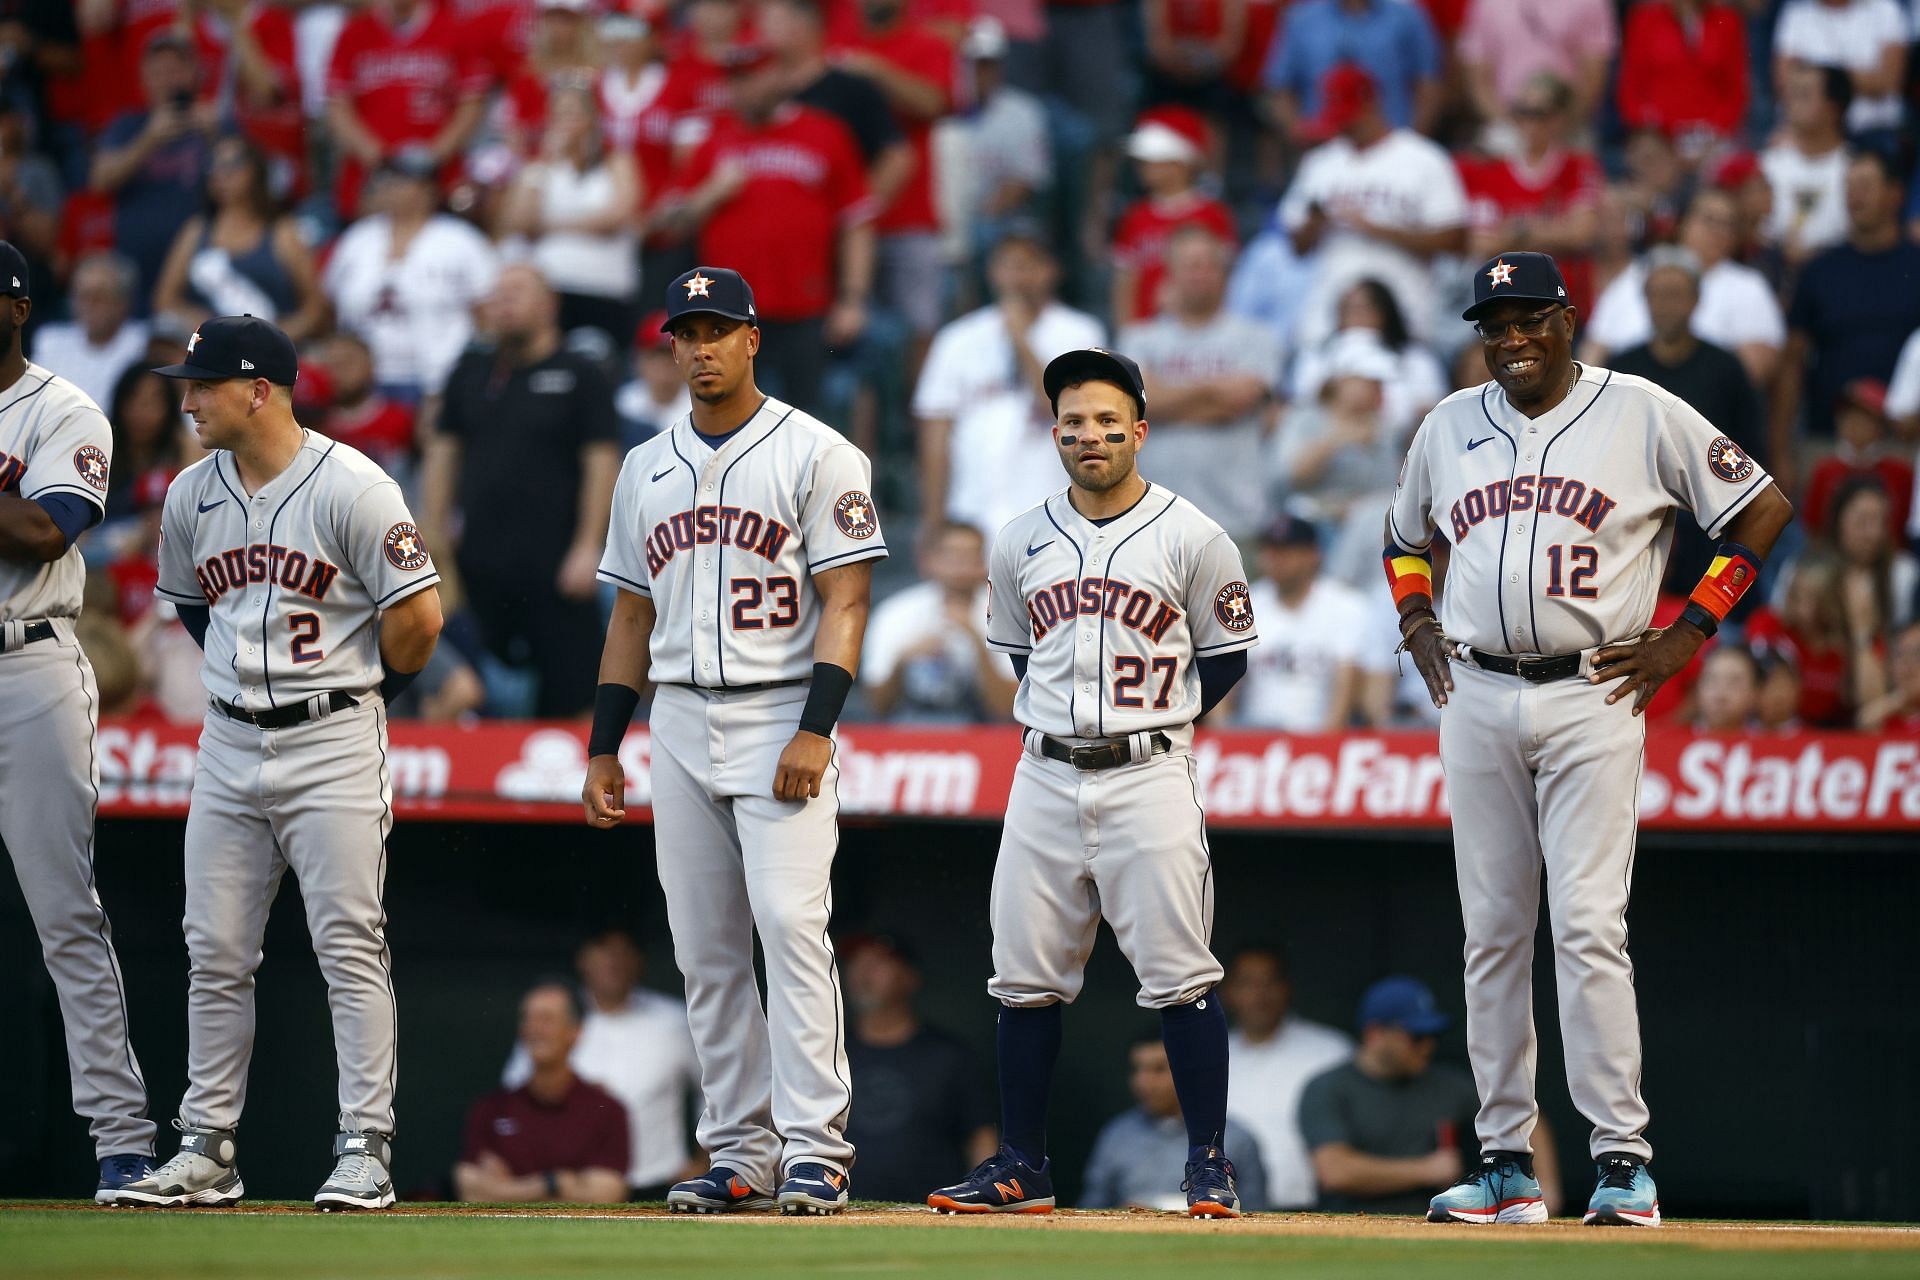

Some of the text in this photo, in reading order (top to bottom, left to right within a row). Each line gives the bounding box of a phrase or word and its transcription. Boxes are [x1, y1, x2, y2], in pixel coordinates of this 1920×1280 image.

[838, 493, 869, 511] HOUSTON
[1450, 474, 1618, 545] HOUSTON
[387, 524, 416, 545] HOUSTON
[646, 505, 791, 581] HOUSTON
[847, 523, 874, 537] ASTROS
[197, 544, 339, 607] HOUSTON
[401, 552, 427, 568] ASTROS
[1546, 544, 1600, 599] 12
[730, 576, 800, 631] 23
[1027, 577, 1182, 645] HOUSTON
[288, 612, 324, 664] 2
[1113, 655, 1178, 710] 27
[344, 1137, 368, 1149] NIKE
[993, 1178, 1025, 1203] N
